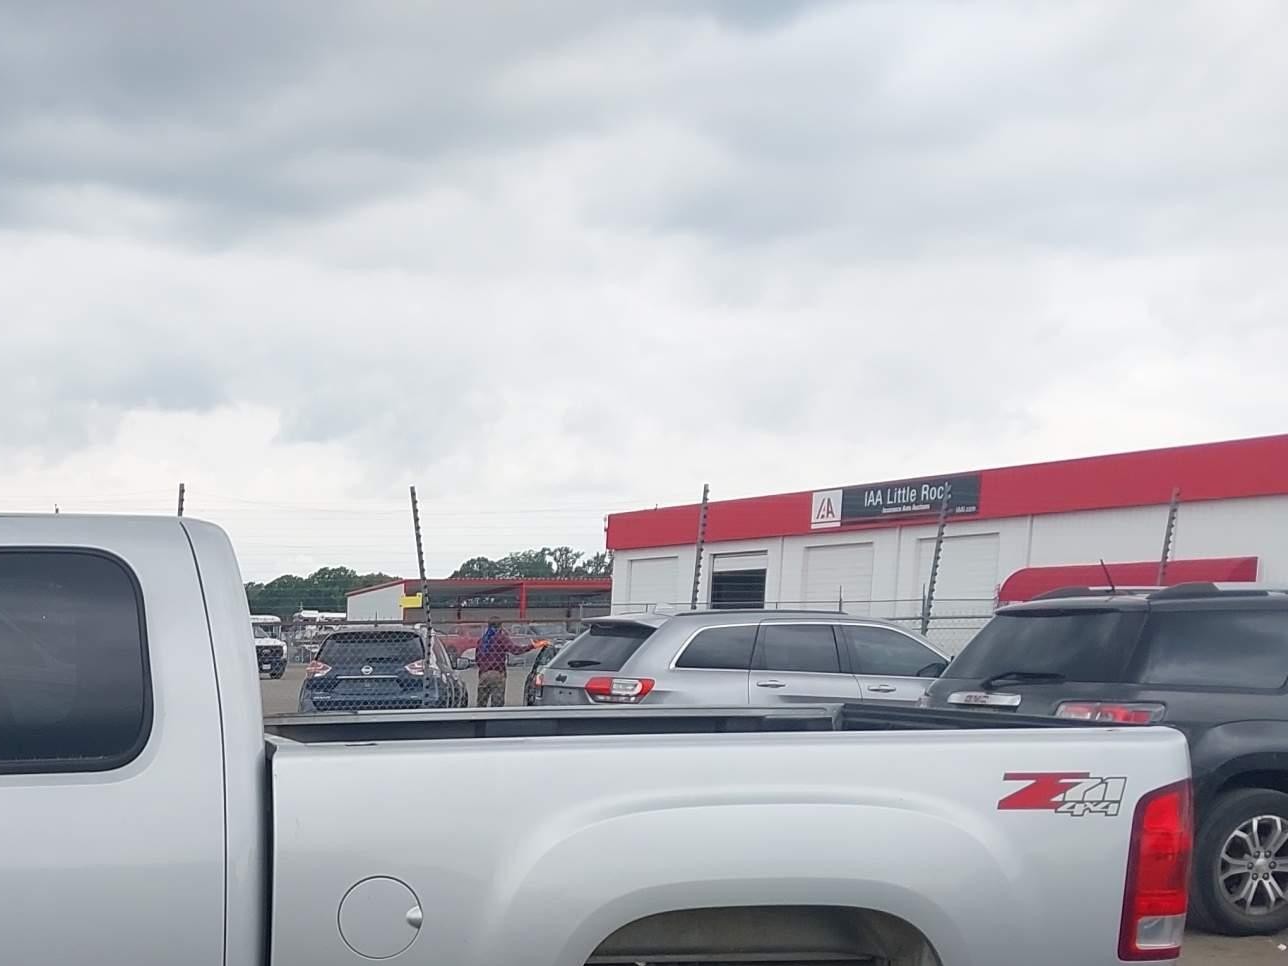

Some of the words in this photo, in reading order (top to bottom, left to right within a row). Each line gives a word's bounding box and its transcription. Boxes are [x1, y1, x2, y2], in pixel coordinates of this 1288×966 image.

[864, 490, 883, 507] IAA
[887, 486, 916, 505] Little
[997, 772, 1127, 810] Z71
[1054, 800, 1122, 817] 4x4
